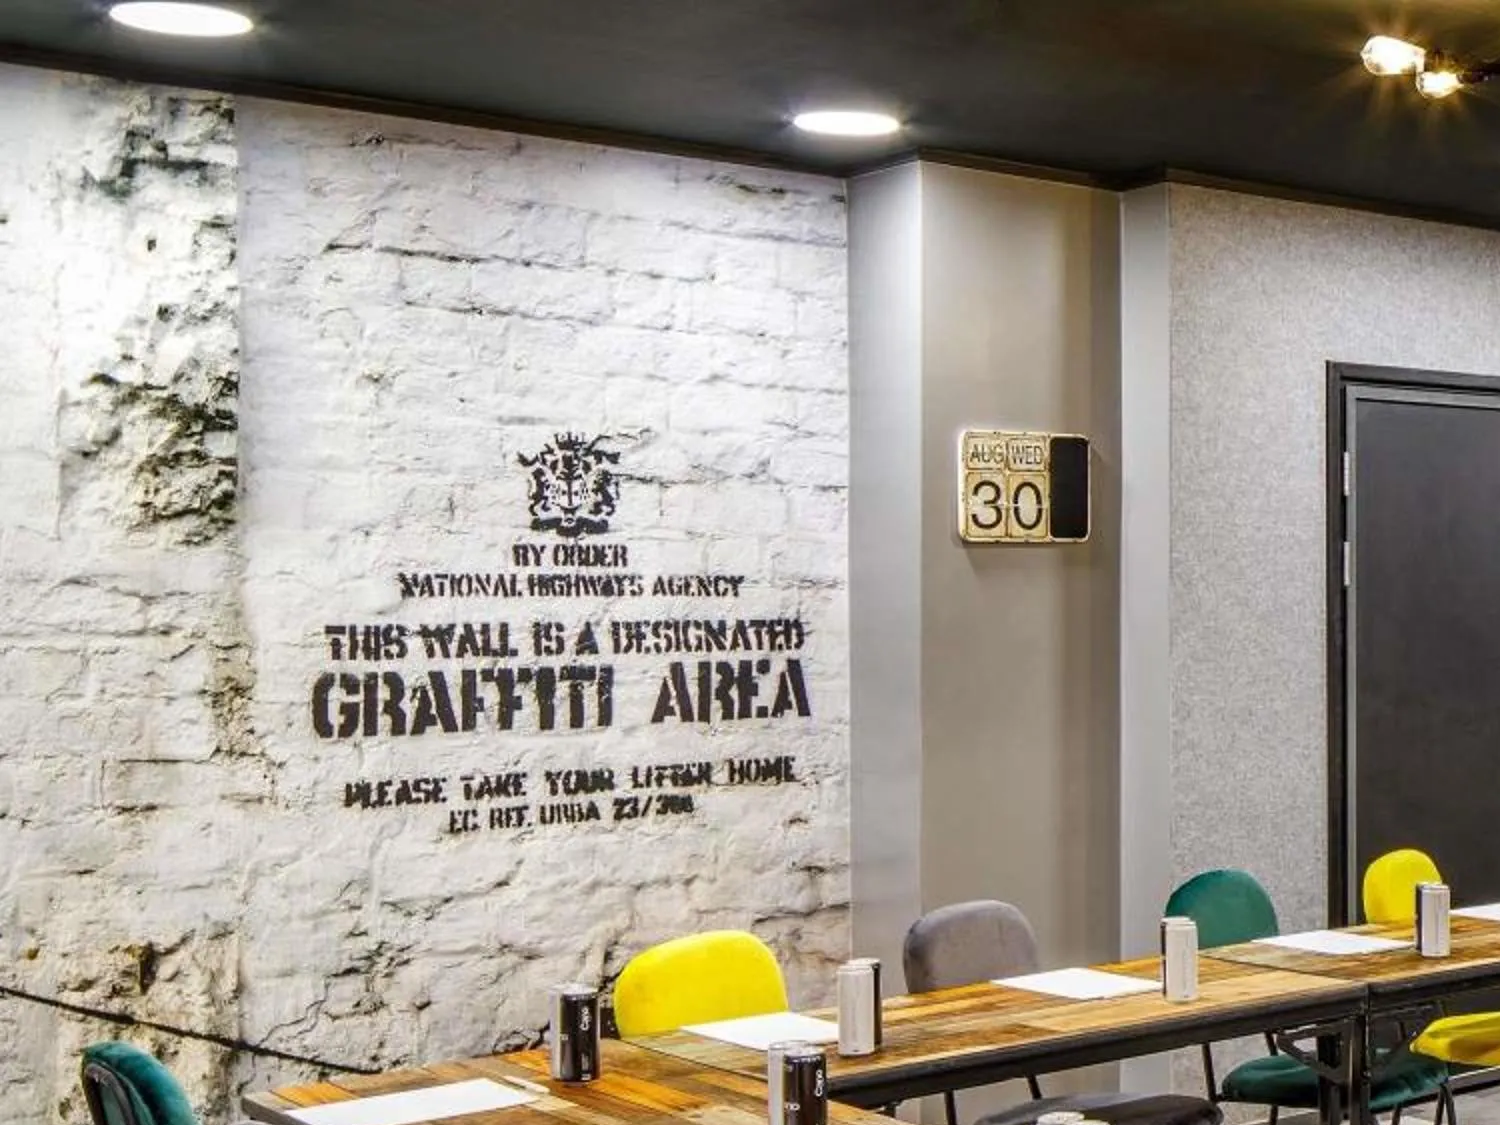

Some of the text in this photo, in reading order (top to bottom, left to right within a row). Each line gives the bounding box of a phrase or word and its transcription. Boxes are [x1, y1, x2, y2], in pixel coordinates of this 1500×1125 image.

[970, 443, 1043, 465] AUG WED
[511, 543, 629, 568] BY ORDER
[398, 572, 745, 598] NATIONAL HIGHWAYS AGENCY
[325, 618, 806, 661] THIS WALL IS A DESIGNATED
[311, 658, 811, 739] GRAFFITI AREA
[344, 756, 797, 809] PLEASE TAKE YOUR LITTER HOME
